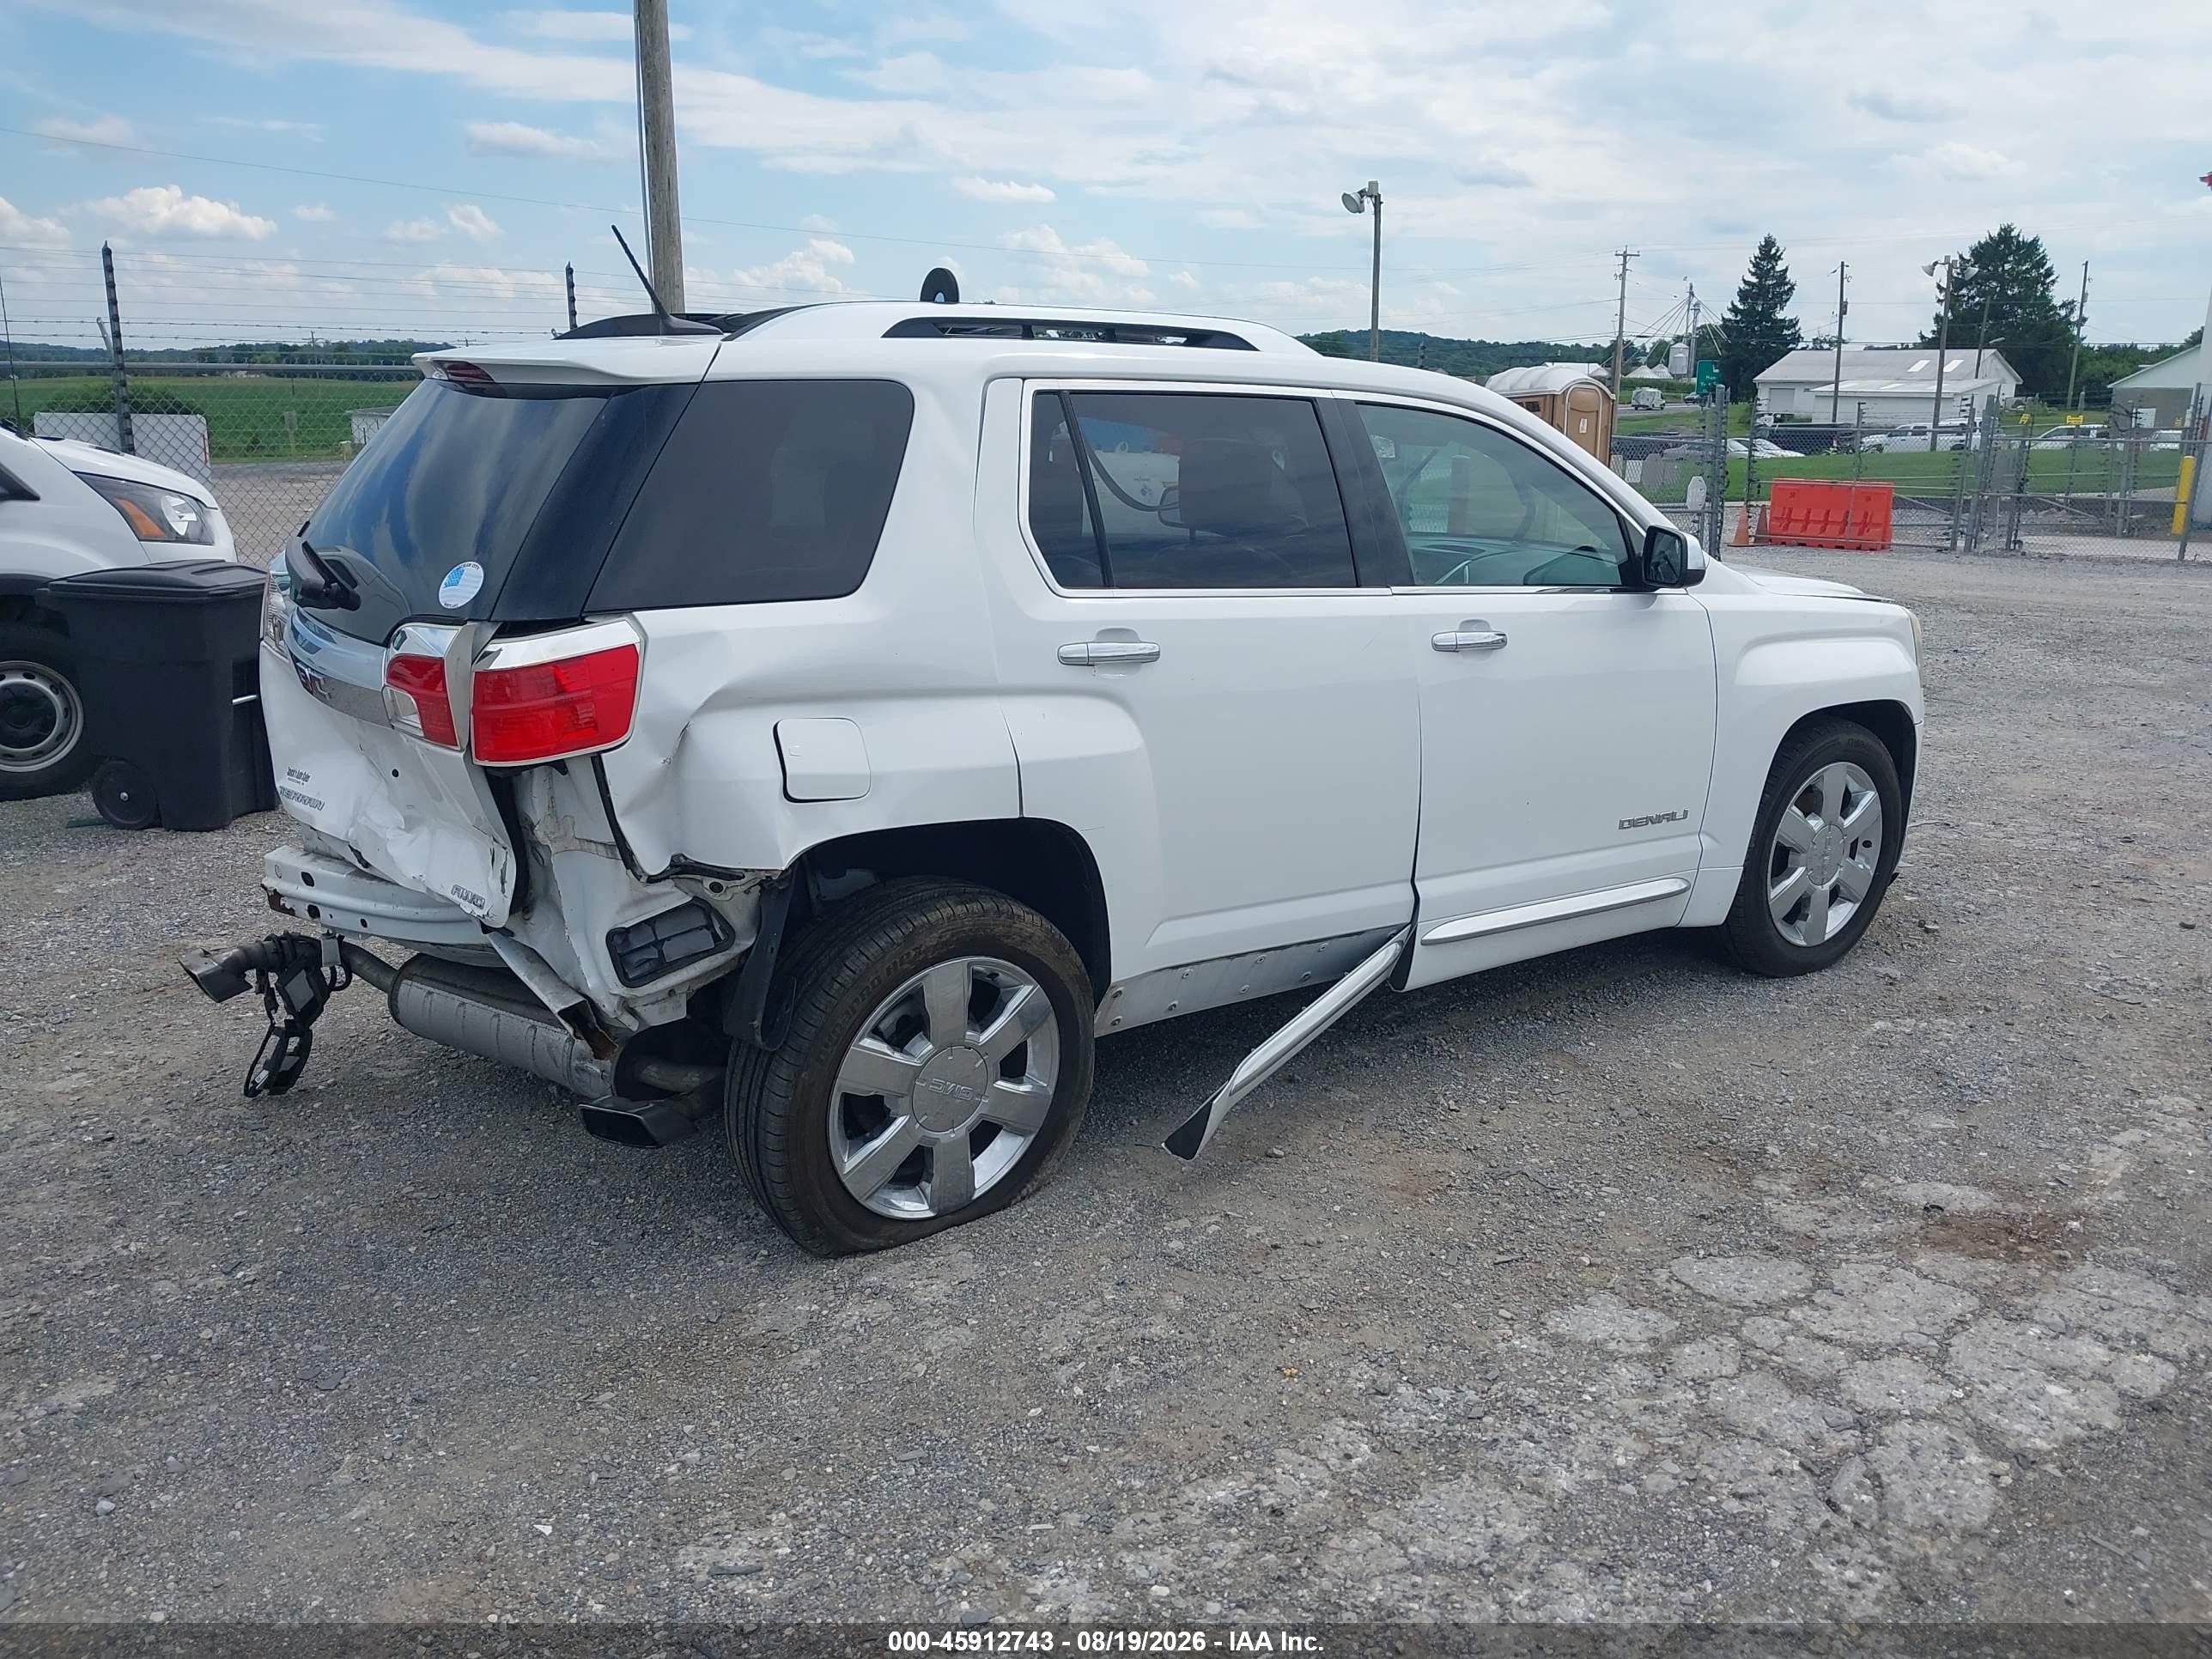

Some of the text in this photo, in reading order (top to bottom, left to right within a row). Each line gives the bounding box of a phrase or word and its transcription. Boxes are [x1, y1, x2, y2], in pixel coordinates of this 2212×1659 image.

[279, 785, 325, 811] TERRAIN
[1618, 808, 1689, 830] DENALI
[451, 884, 486, 909] AWD
[928, 1078, 974, 1101] GMC
